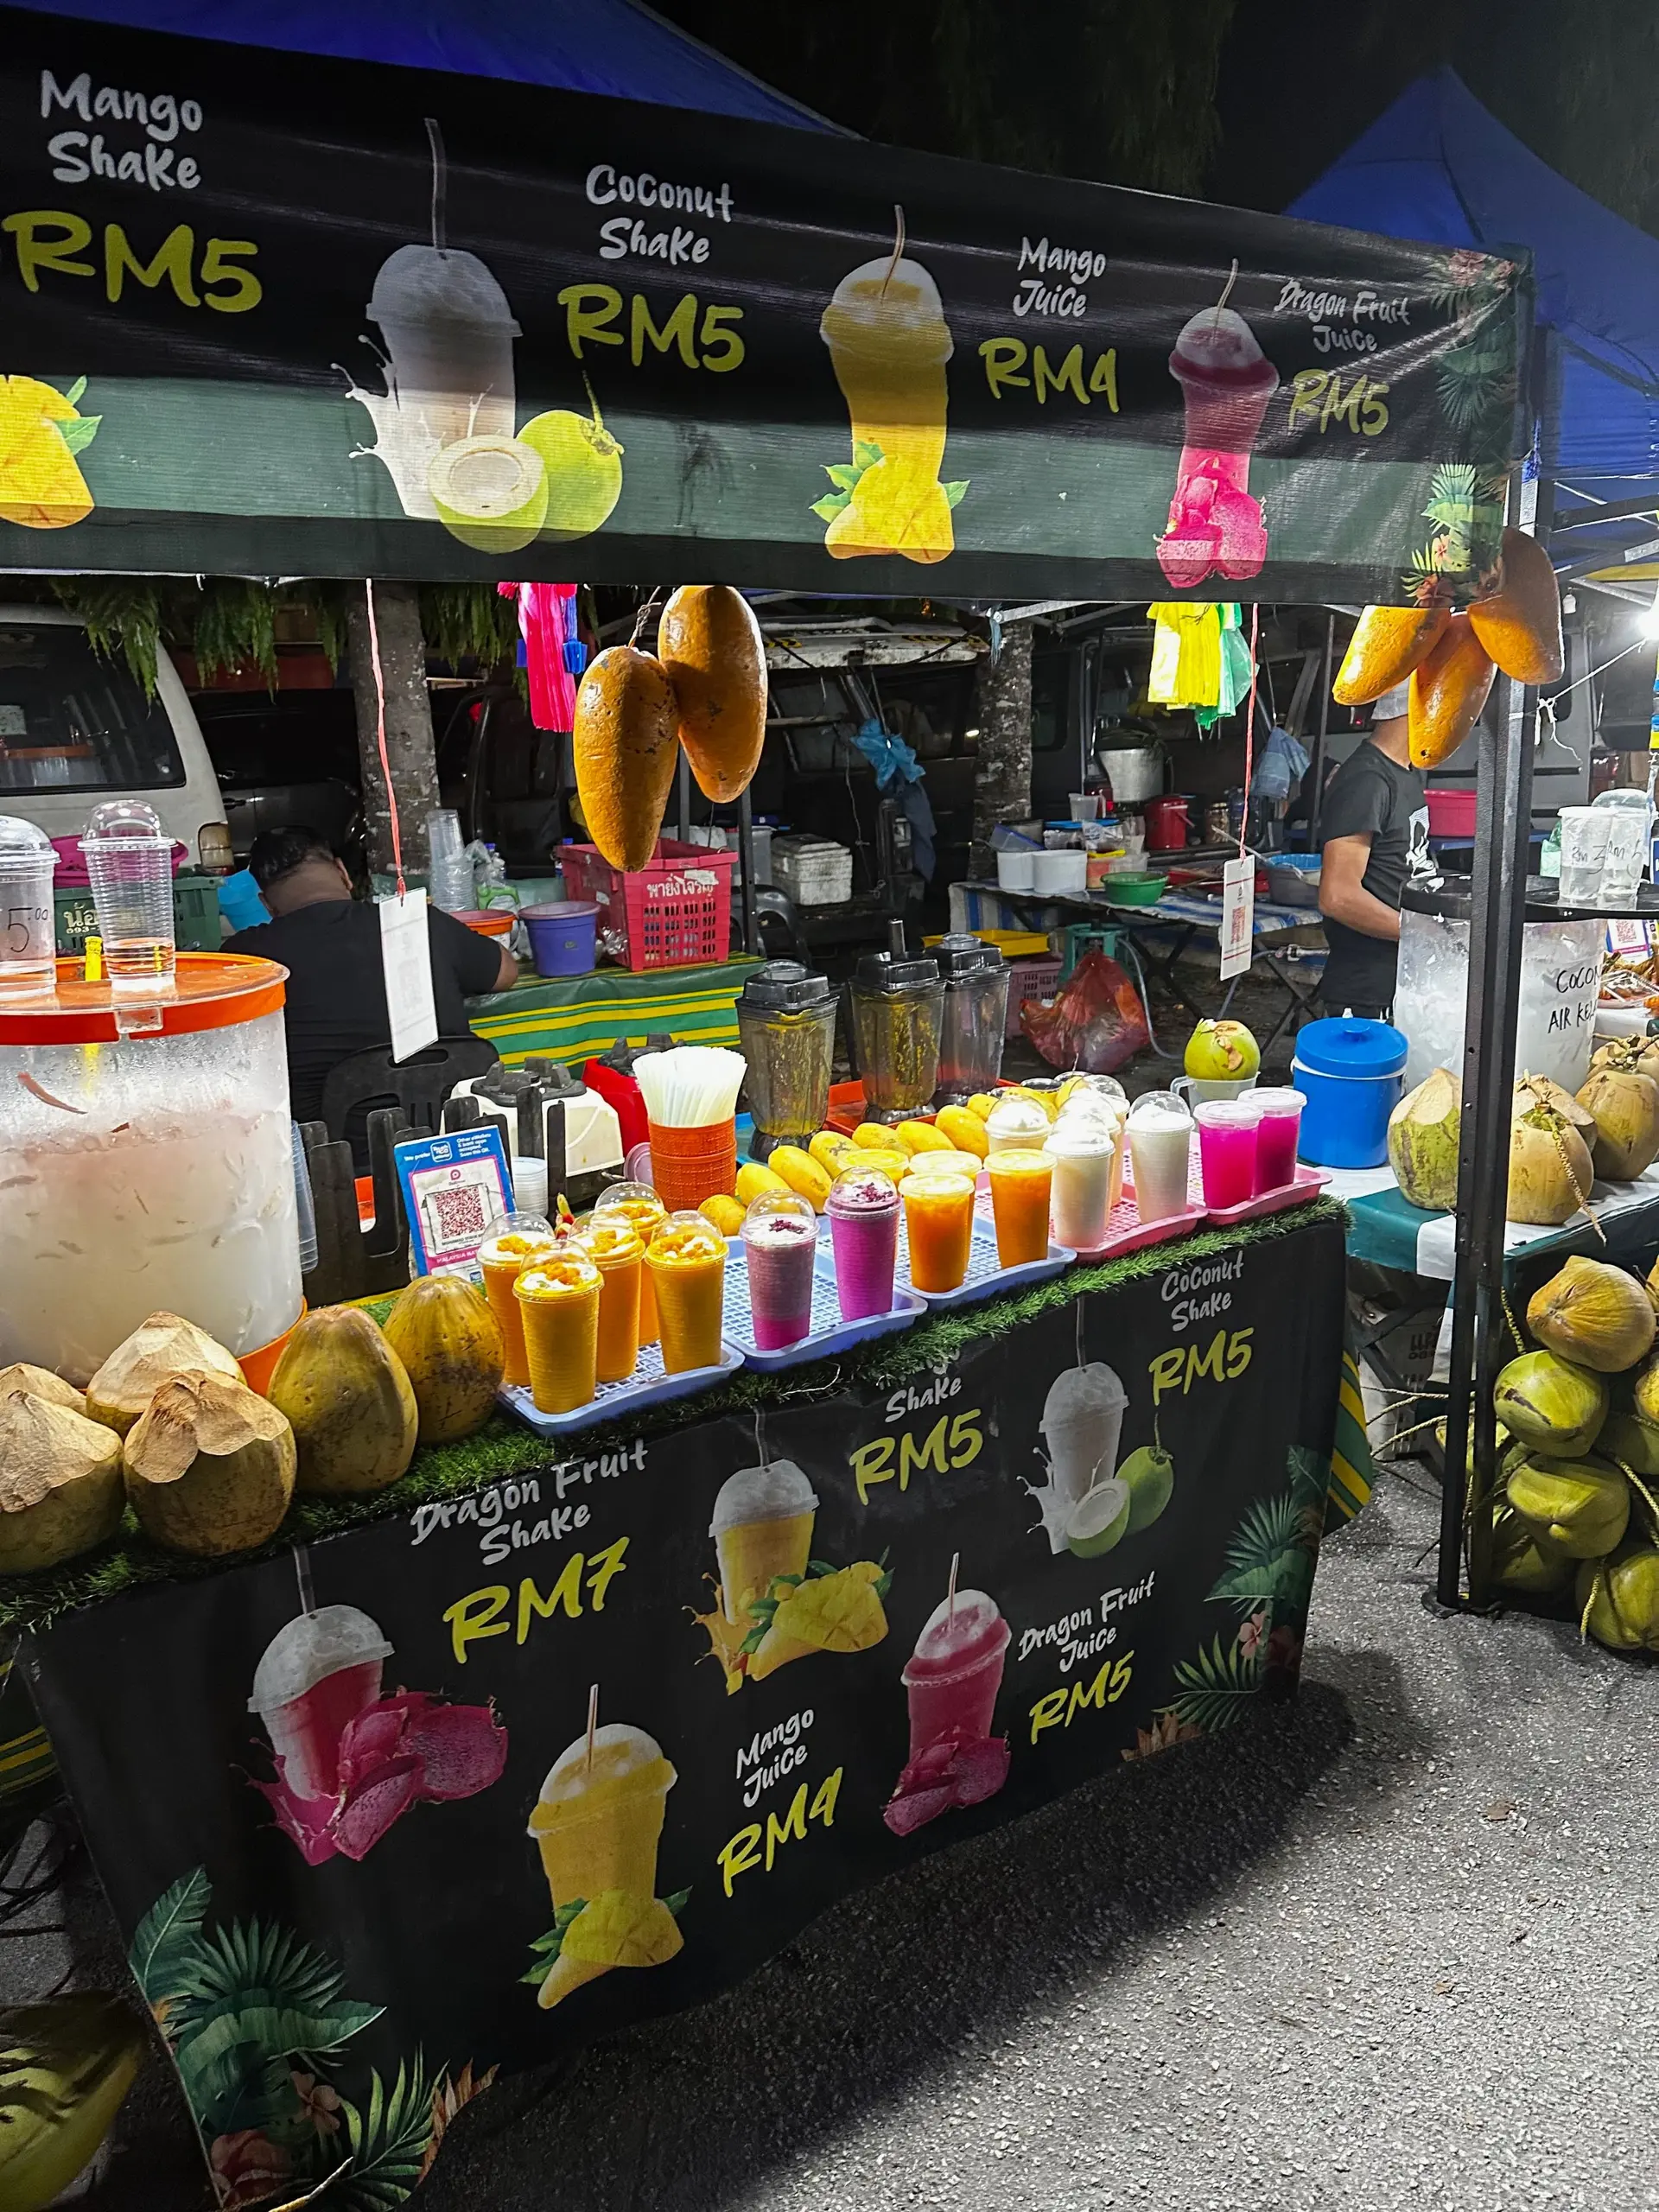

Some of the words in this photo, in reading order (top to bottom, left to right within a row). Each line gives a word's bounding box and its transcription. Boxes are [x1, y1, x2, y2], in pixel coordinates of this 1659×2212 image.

[41, 70, 202, 143] Mango
[48, 130, 201, 192] Shake
[586, 163, 734, 222] Coconut
[3, 210, 263, 314] RM5
[599, 217, 711, 265] Shake
[1017, 236, 1106, 284] Mango
[557, 283, 746, 372] RM5
[1013, 279, 1088, 318] Juice
[1274, 279, 1348, 325] Dragon
[1351, 289, 1411, 326] Fruit
[1313, 324, 1378, 353] Juice
[978, 336, 1120, 414] RM4
[1287, 369, 1390, 436] RM5
[1548, 1006, 1572, 1033] AIR
[1160, 1250, 1244, 1303] Coconut
[1170, 1288, 1232, 1332] Shake
[1148, 1326, 1255, 1407] RM5
[885, 1375, 963, 1424] Shake
[849, 1408, 983, 1505] RM5
[410, 1478, 541, 1546] Dragon
[550, 1438, 649, 1499] Fruit
[479, 1503, 592, 1566] Shake
[442, 1535, 631, 1664] RM7
[1016, 1605, 1093, 1662] Dragon
[1099, 1569, 1156, 1623] Fruit
[1059, 1626, 1117, 1674] Juice
[1028, 1650, 1135, 1745] RM5
[735, 1707, 815, 1779] Mango
[742, 1743, 808, 1808] Juice
[716, 1766, 844, 1898] RM4
